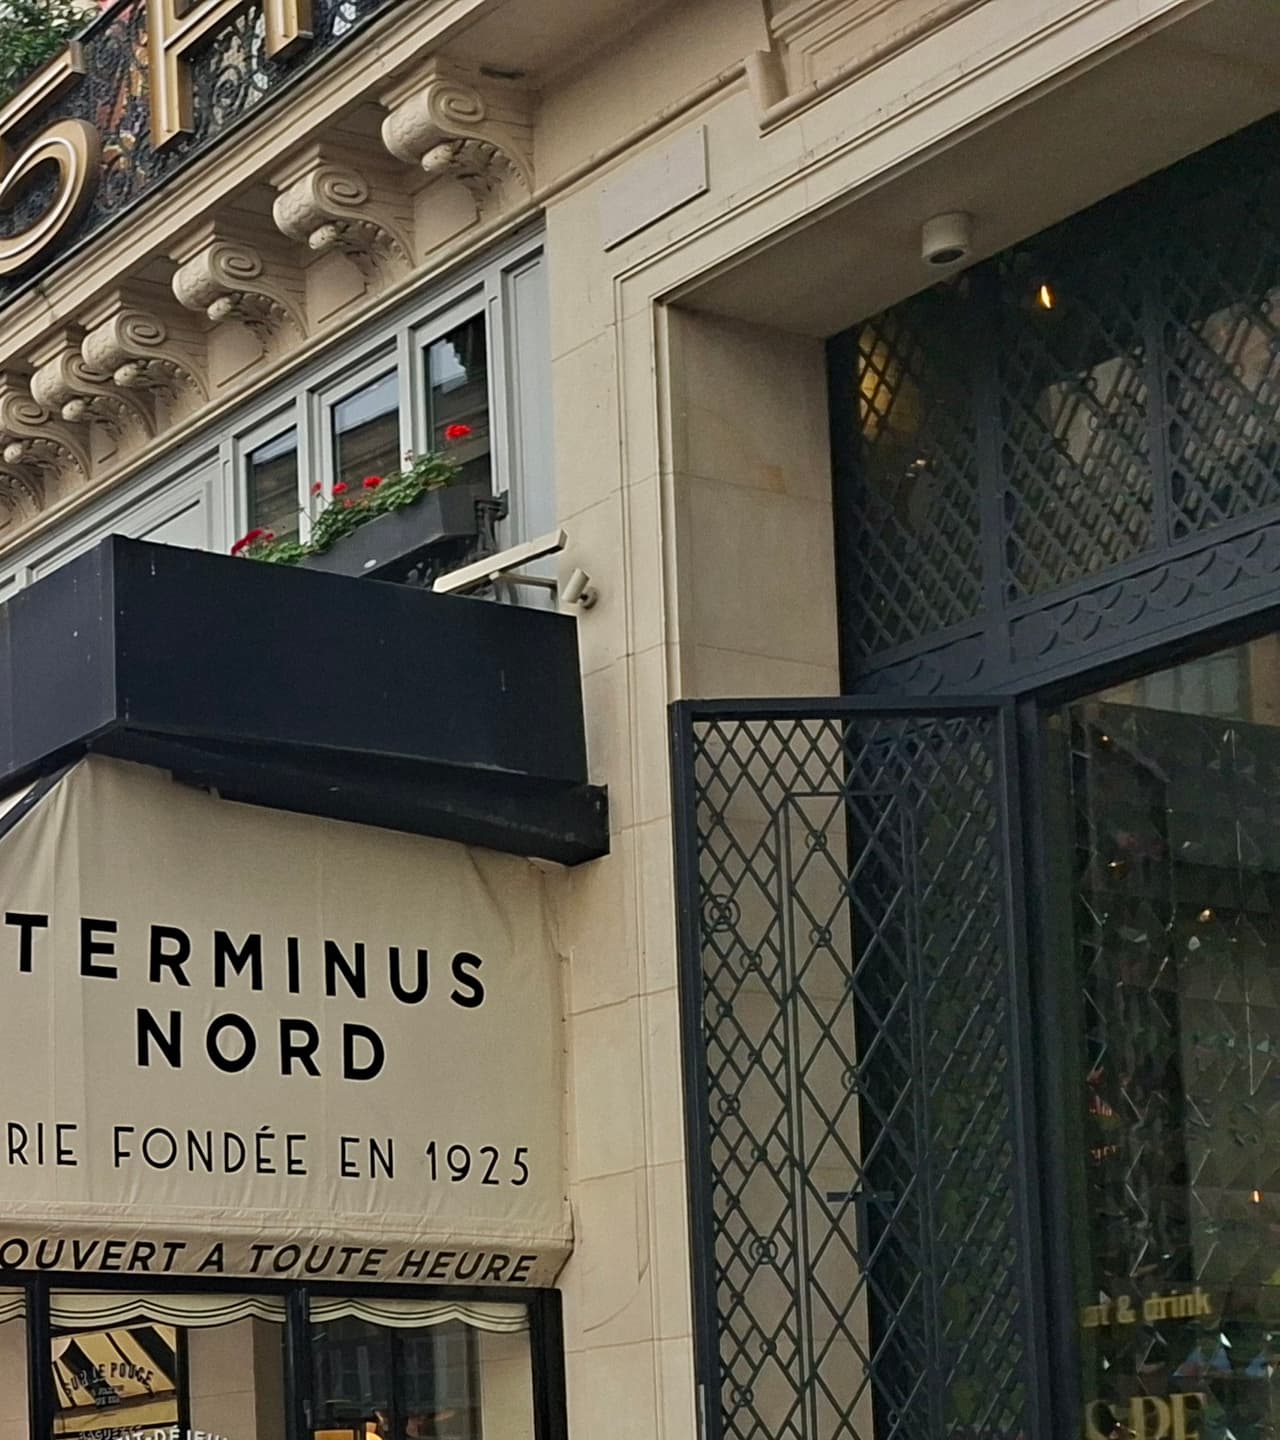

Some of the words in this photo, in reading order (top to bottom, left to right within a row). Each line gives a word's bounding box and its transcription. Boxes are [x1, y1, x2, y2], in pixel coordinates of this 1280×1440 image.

[5, 911, 486, 1008] TERMINUS
[137, 1008, 385, 1082] NORD
[113, 1125, 307, 1176] FONDÉE
[340, 1136, 395, 1179] EN
[426, 1141, 529, 1186] 1925
[197, 1242, 225, 1273] A
[249, 1244, 388, 1276] TOUTE
[397, 1249, 538, 1283] HEURE
[1144, 1286, 1211, 1322] drink
